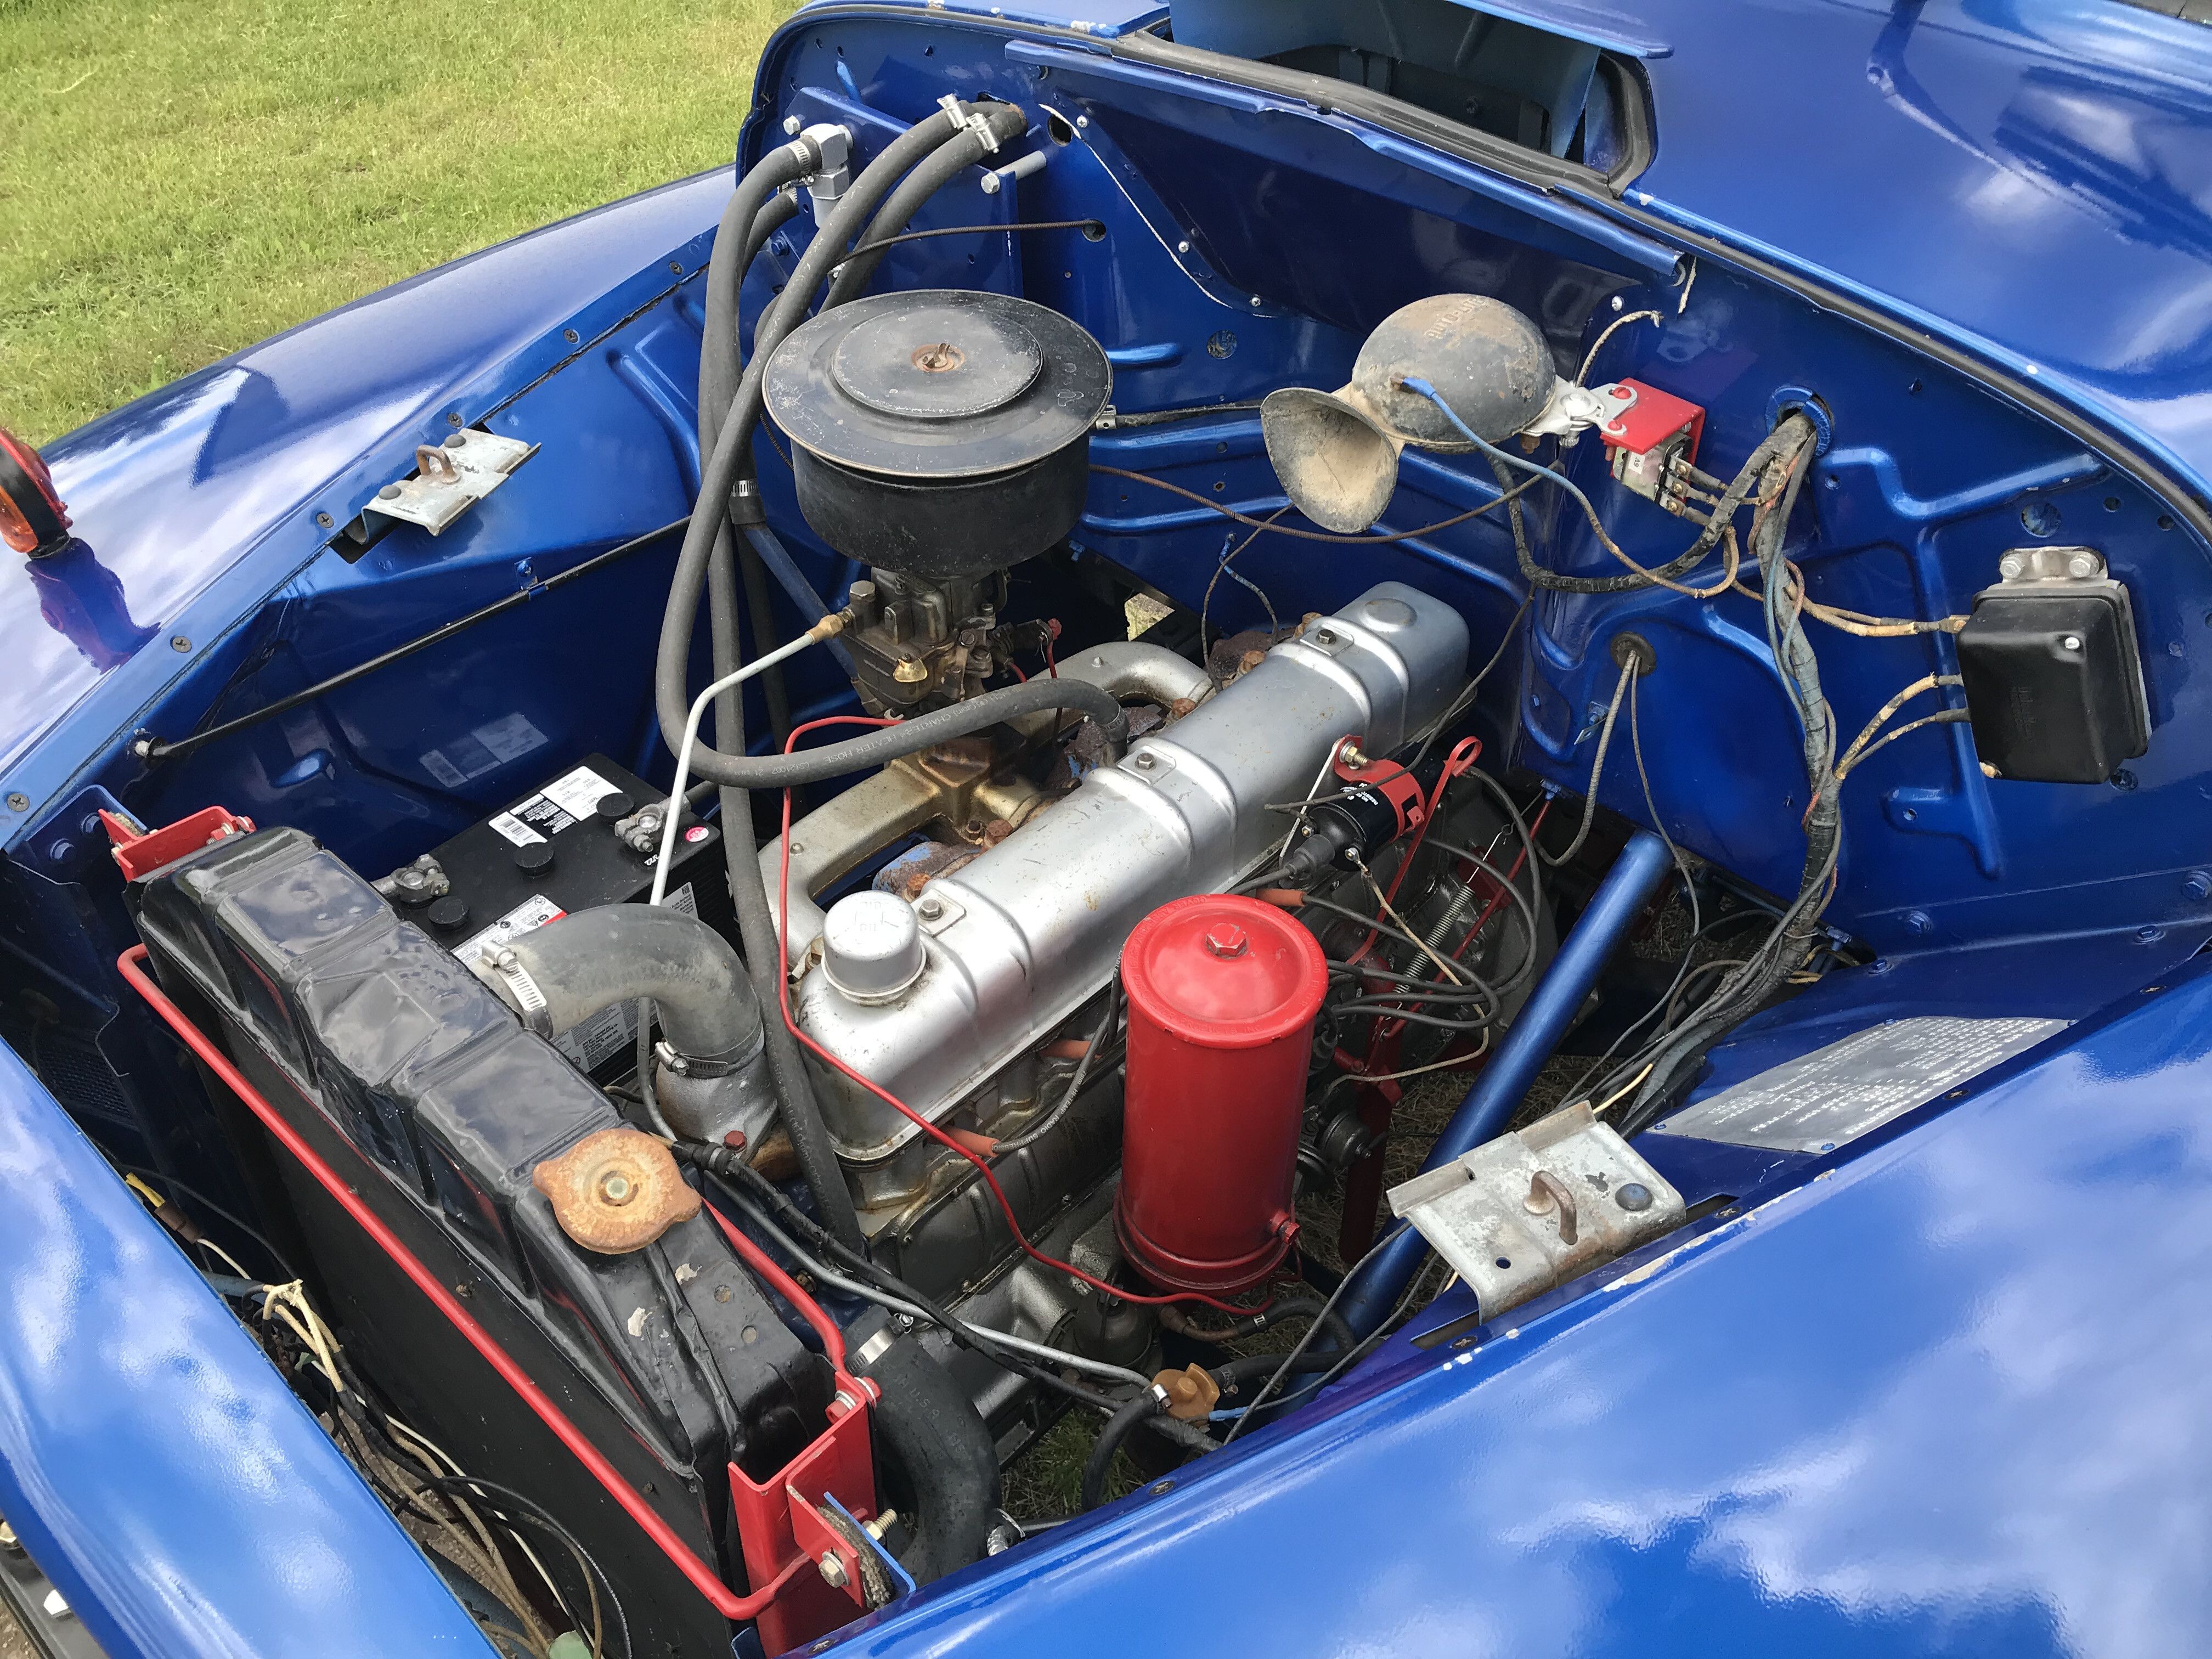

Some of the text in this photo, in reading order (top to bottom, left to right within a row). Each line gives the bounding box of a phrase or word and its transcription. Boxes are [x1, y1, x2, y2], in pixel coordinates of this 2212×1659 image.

[855, 733, 897, 754] HEATER
[823, 748, 854, 763] HOSE
[1173, 896, 1207, 910] COVER
[1060, 1088, 1079, 1115] HI-TEMP
[1040, 1115, 1060, 1133] RADIO
[992, 1133, 1039, 1150] SUPPRESSIO
